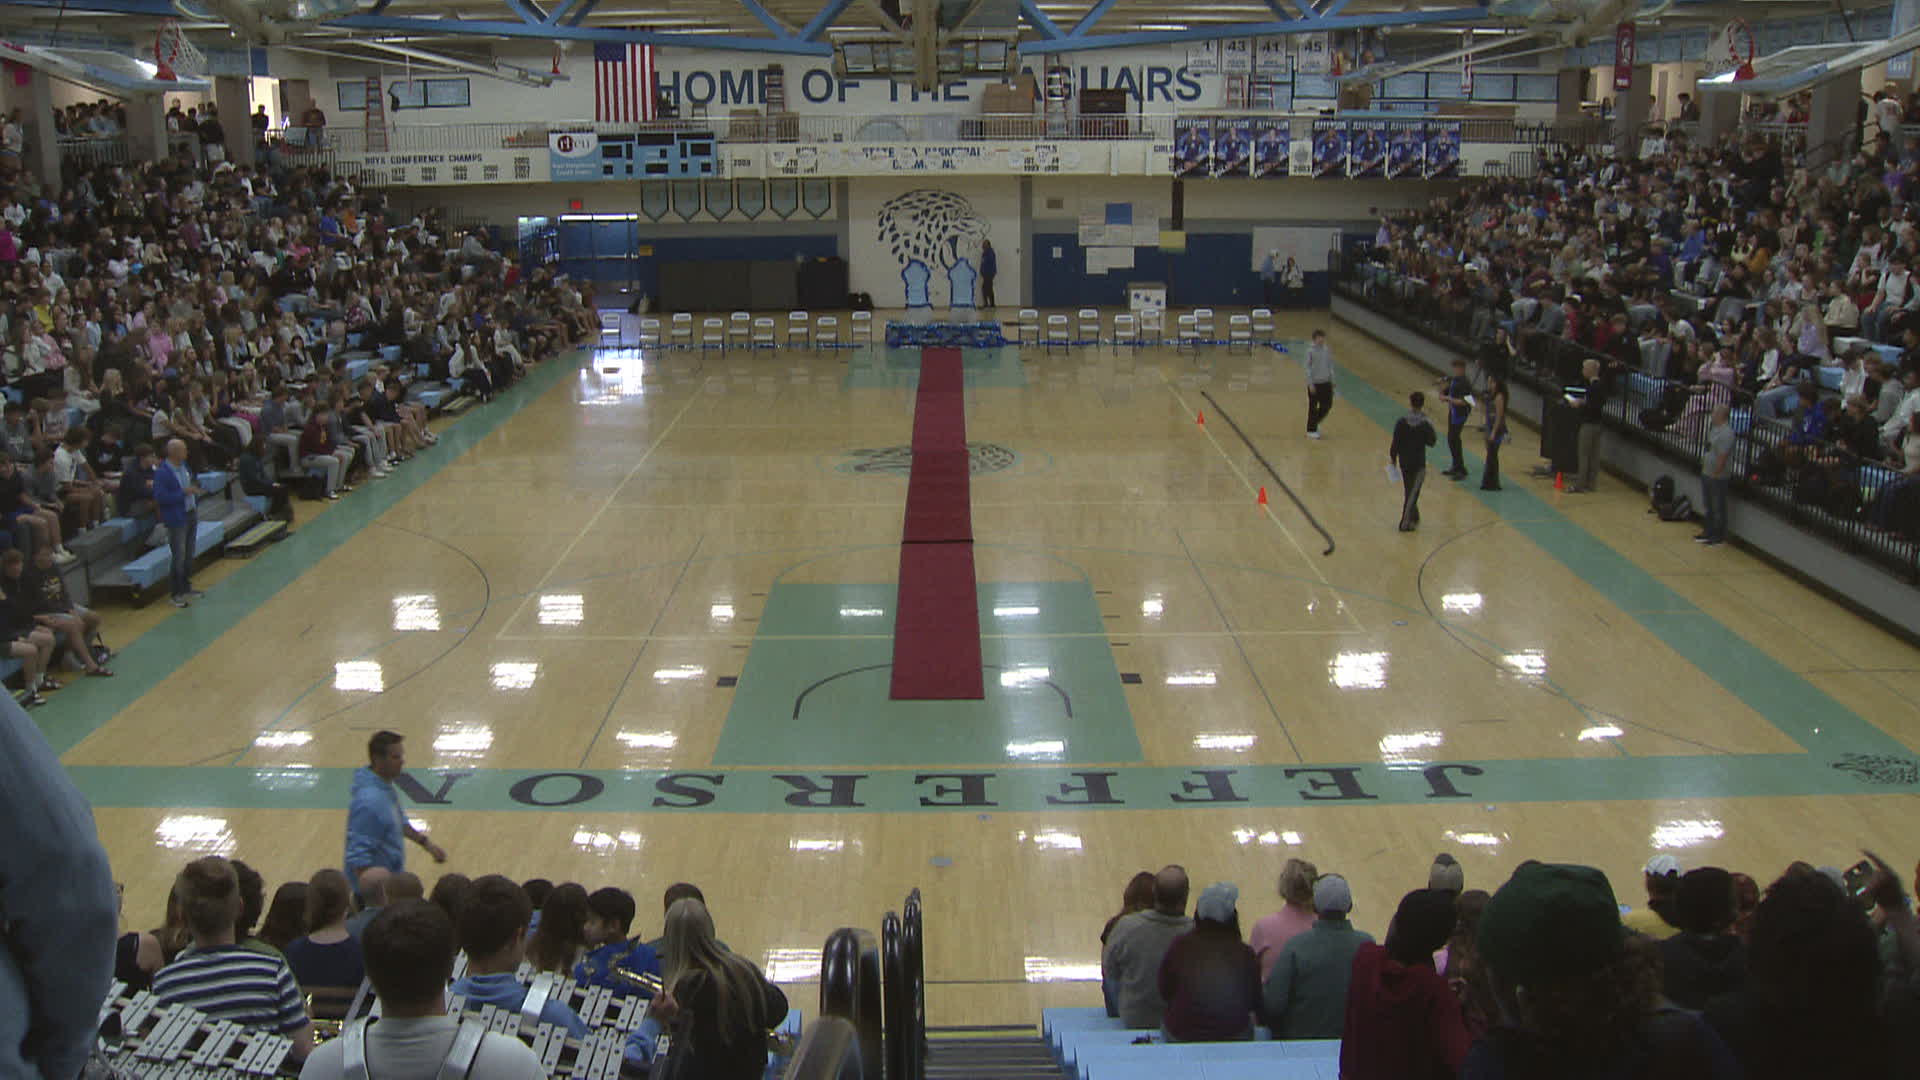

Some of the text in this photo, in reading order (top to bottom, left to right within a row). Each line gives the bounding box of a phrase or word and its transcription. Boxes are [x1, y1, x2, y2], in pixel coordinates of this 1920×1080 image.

[1228, 40, 1245, 51] 43
[654, 68, 784, 105] HOME
[1001, 66, 1202, 102] AGUARS
[390, 154, 444, 164] CONFERENCE
[449, 153, 483, 163] CHAMPS
[397, 763, 1484, 808] JEFFERSON
